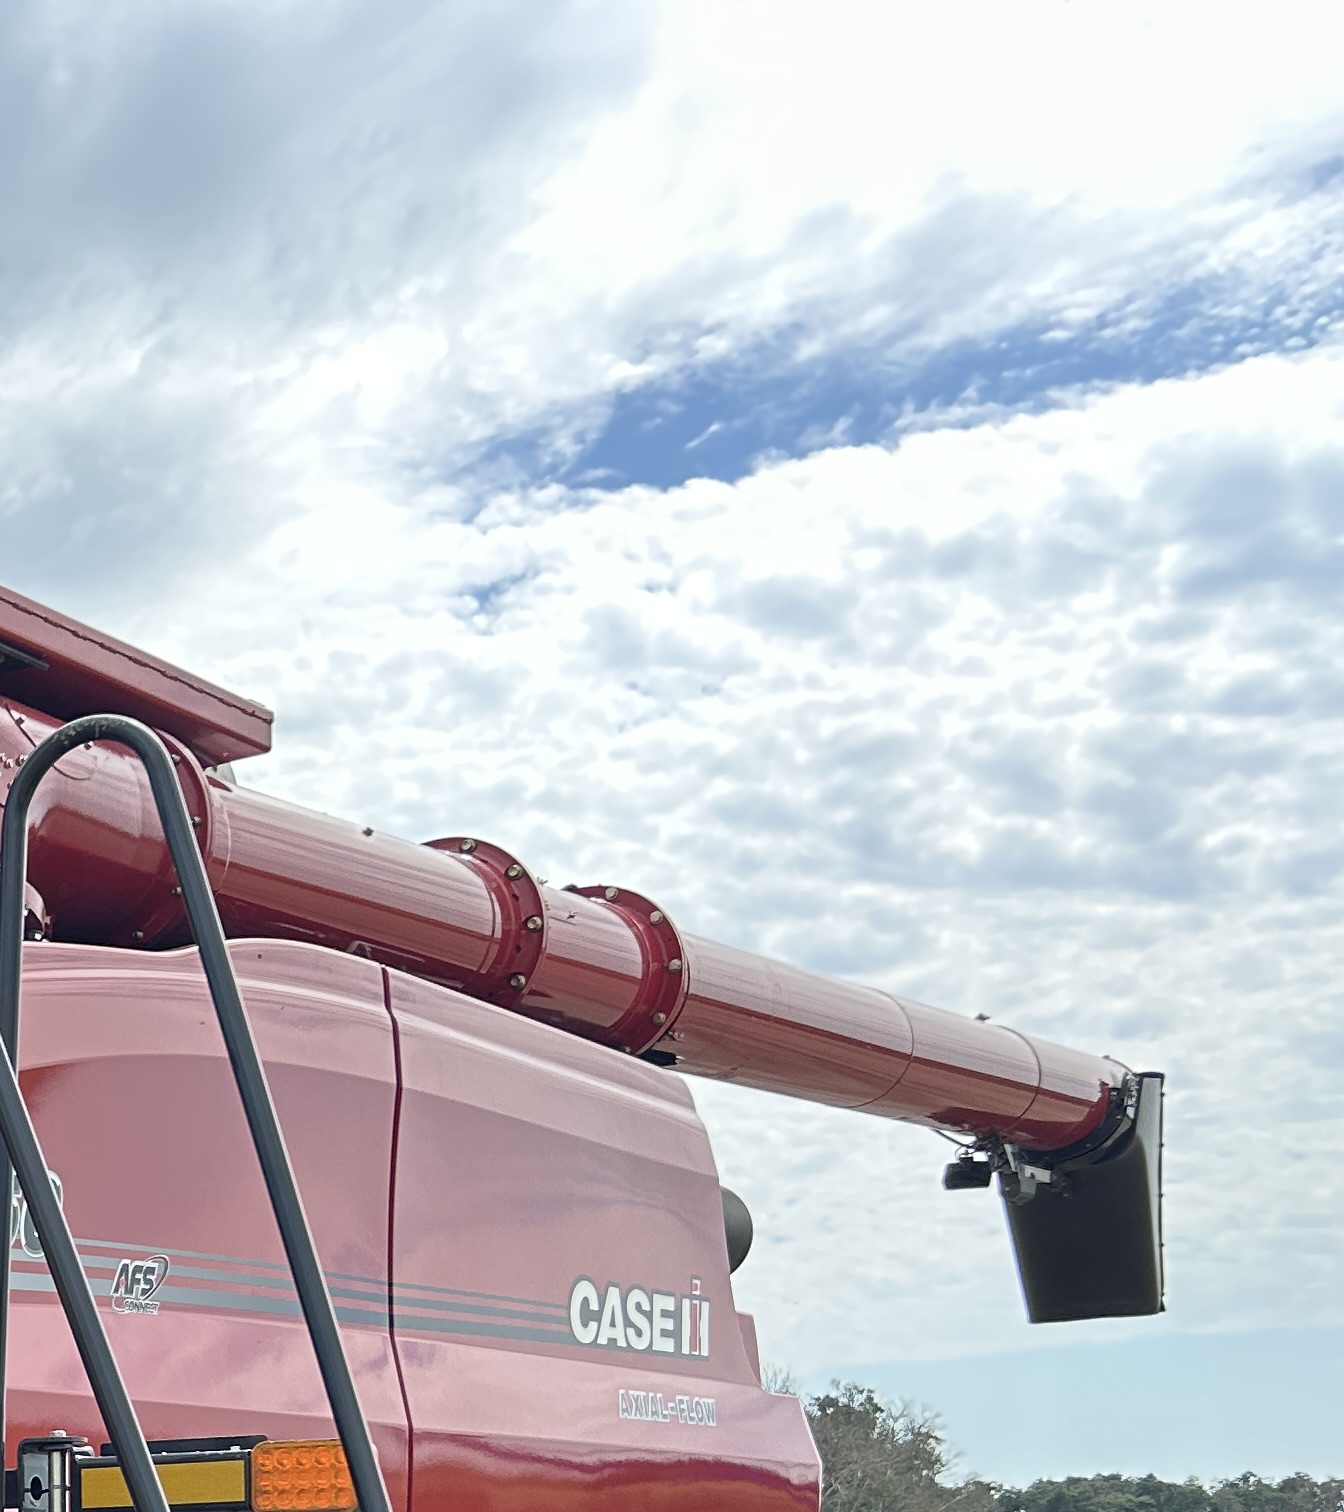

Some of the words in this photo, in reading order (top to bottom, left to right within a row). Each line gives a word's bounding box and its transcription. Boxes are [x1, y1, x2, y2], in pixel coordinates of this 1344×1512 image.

[110, 1258, 159, 1299] AFS
[570, 1279, 676, 1353] CASE
[618, 1388, 717, 1427] AXIAL-FLOW
